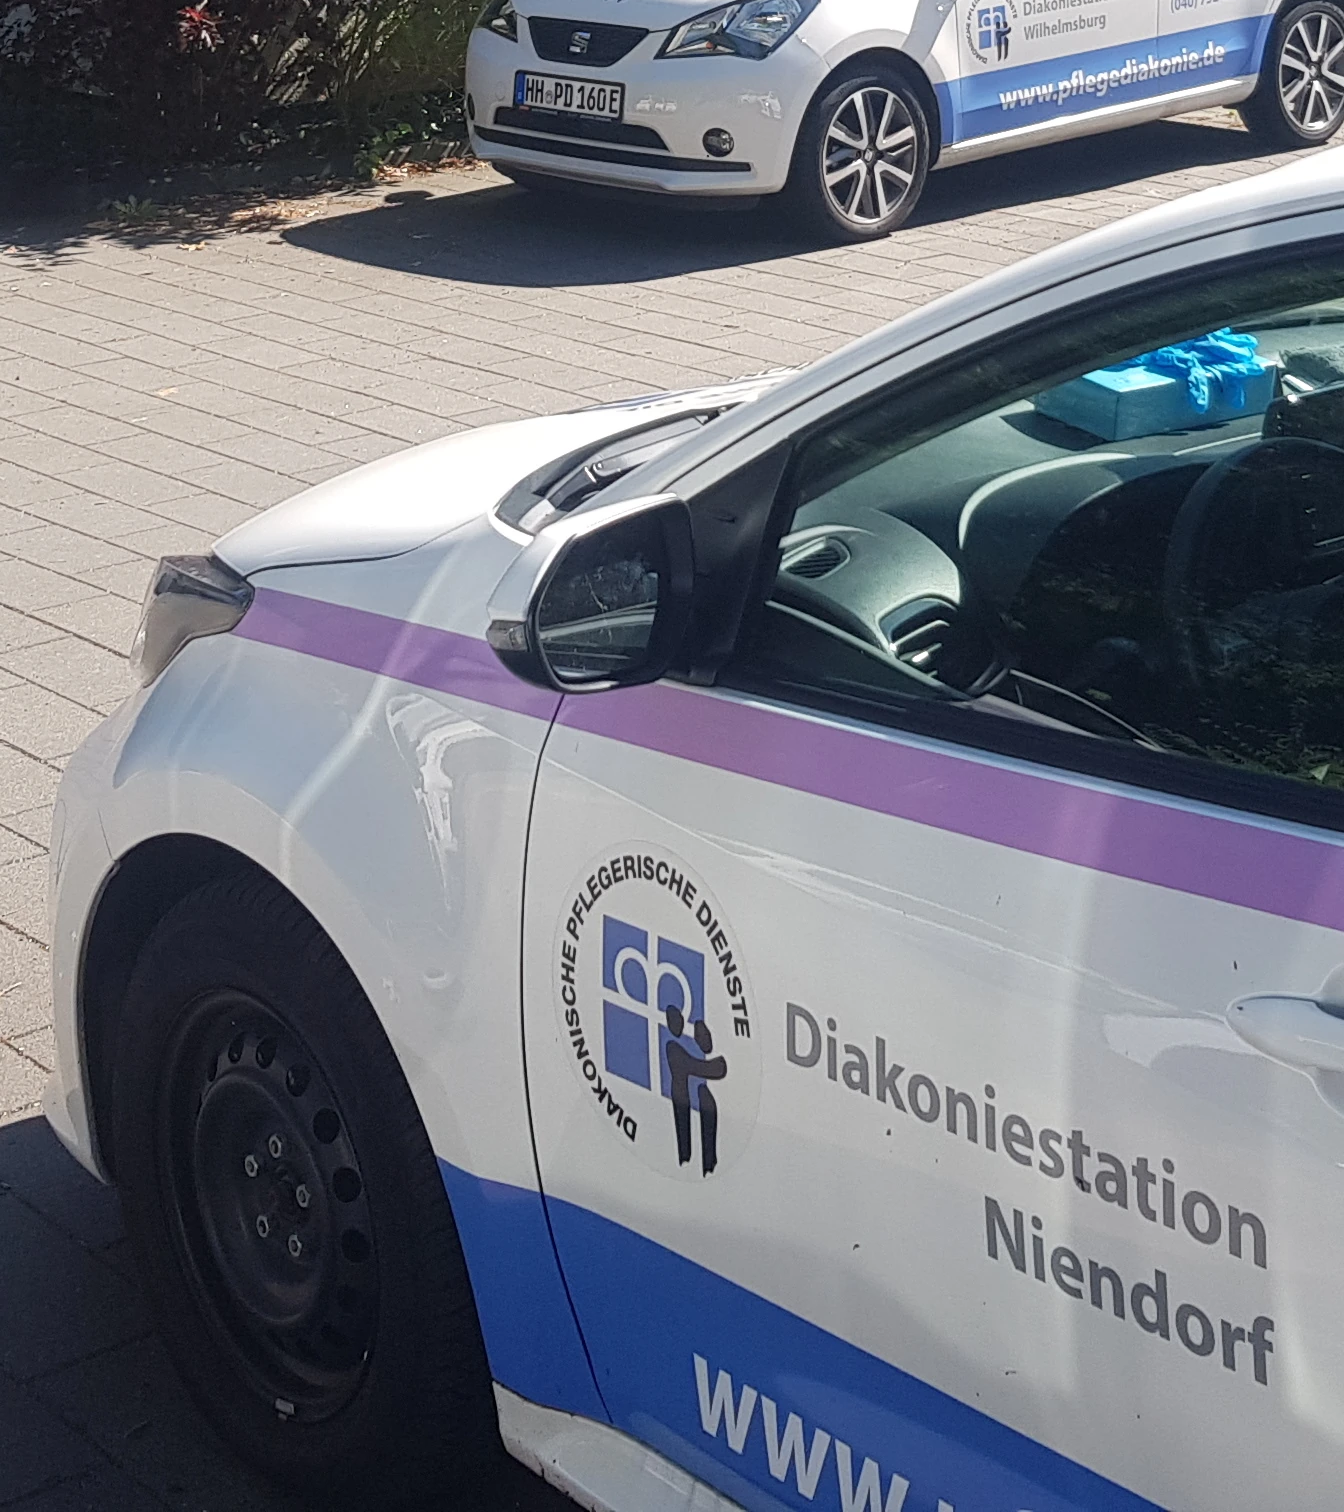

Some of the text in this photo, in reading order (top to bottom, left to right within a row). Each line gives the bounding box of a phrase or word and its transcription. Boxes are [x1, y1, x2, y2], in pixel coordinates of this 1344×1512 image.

[525, 77, 545, 104] HH
[553, 81, 574, 108] PD
[999, 40, 1226, 111] www.pflegediakonie.de
[1023, 14, 1106, 41] Wilhelmsburg
[560, 854, 751, 1143] DIAKONISCHE PFLEGERISCHE DIENSTE
[784, 1001, 1270, 1271] Diakoniestation
[983, 1194, 1277, 1386] Niendorf
